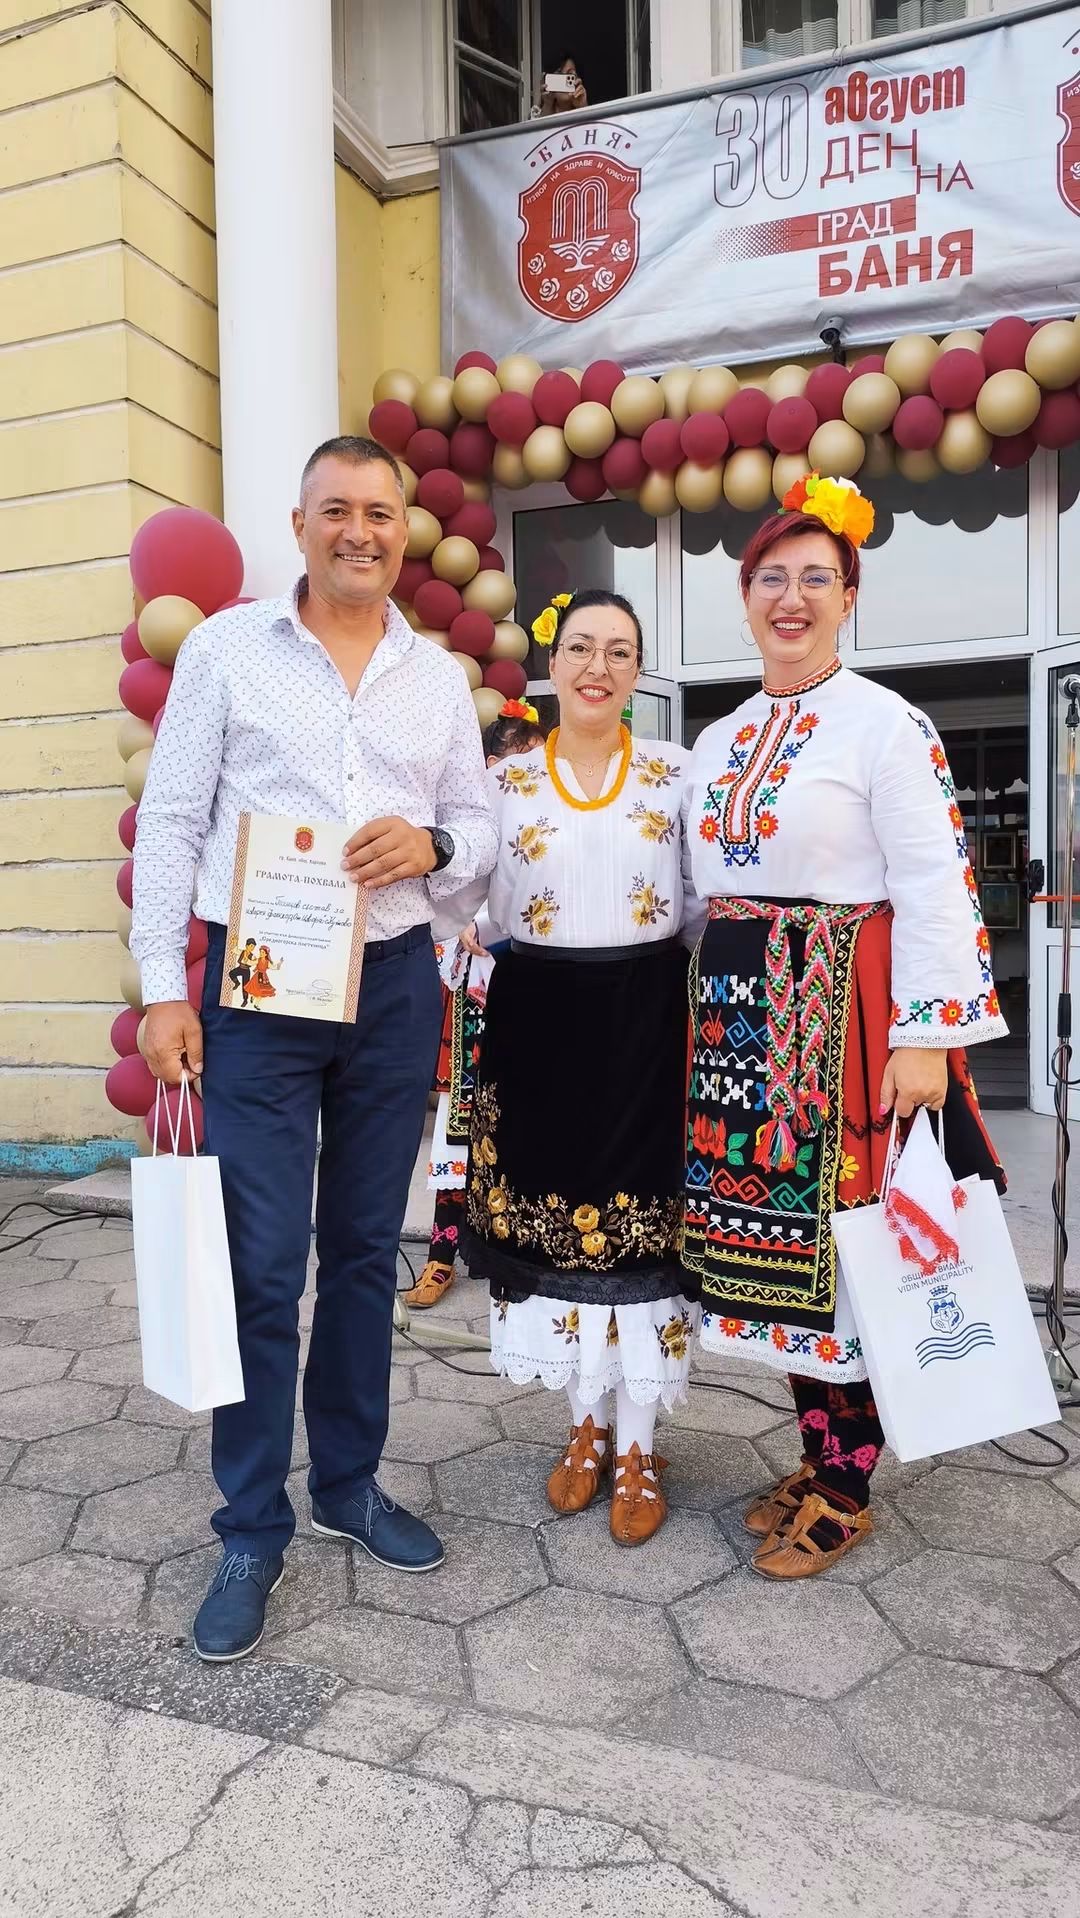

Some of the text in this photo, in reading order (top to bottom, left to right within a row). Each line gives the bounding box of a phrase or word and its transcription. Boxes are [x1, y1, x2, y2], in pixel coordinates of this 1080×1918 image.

[538, 129, 622, 163] БАНЯ
[714, 65, 966, 208] 30 август
[550, 171, 561, 182] НА
[564, 159, 594, 172] ЗДРАВЕ
[605, 167, 636, 183] КРАСОТА
[819, 128, 974, 194] ДЕН НА
[817, 202, 895, 243] ГРАД
[818, 228, 974, 297] БАНЯ
[255, 870, 346, 889] ГРАМОТА-ПОХВАЛА
[897, 1265, 974, 1294] VIDIN MUNICIPALITY
